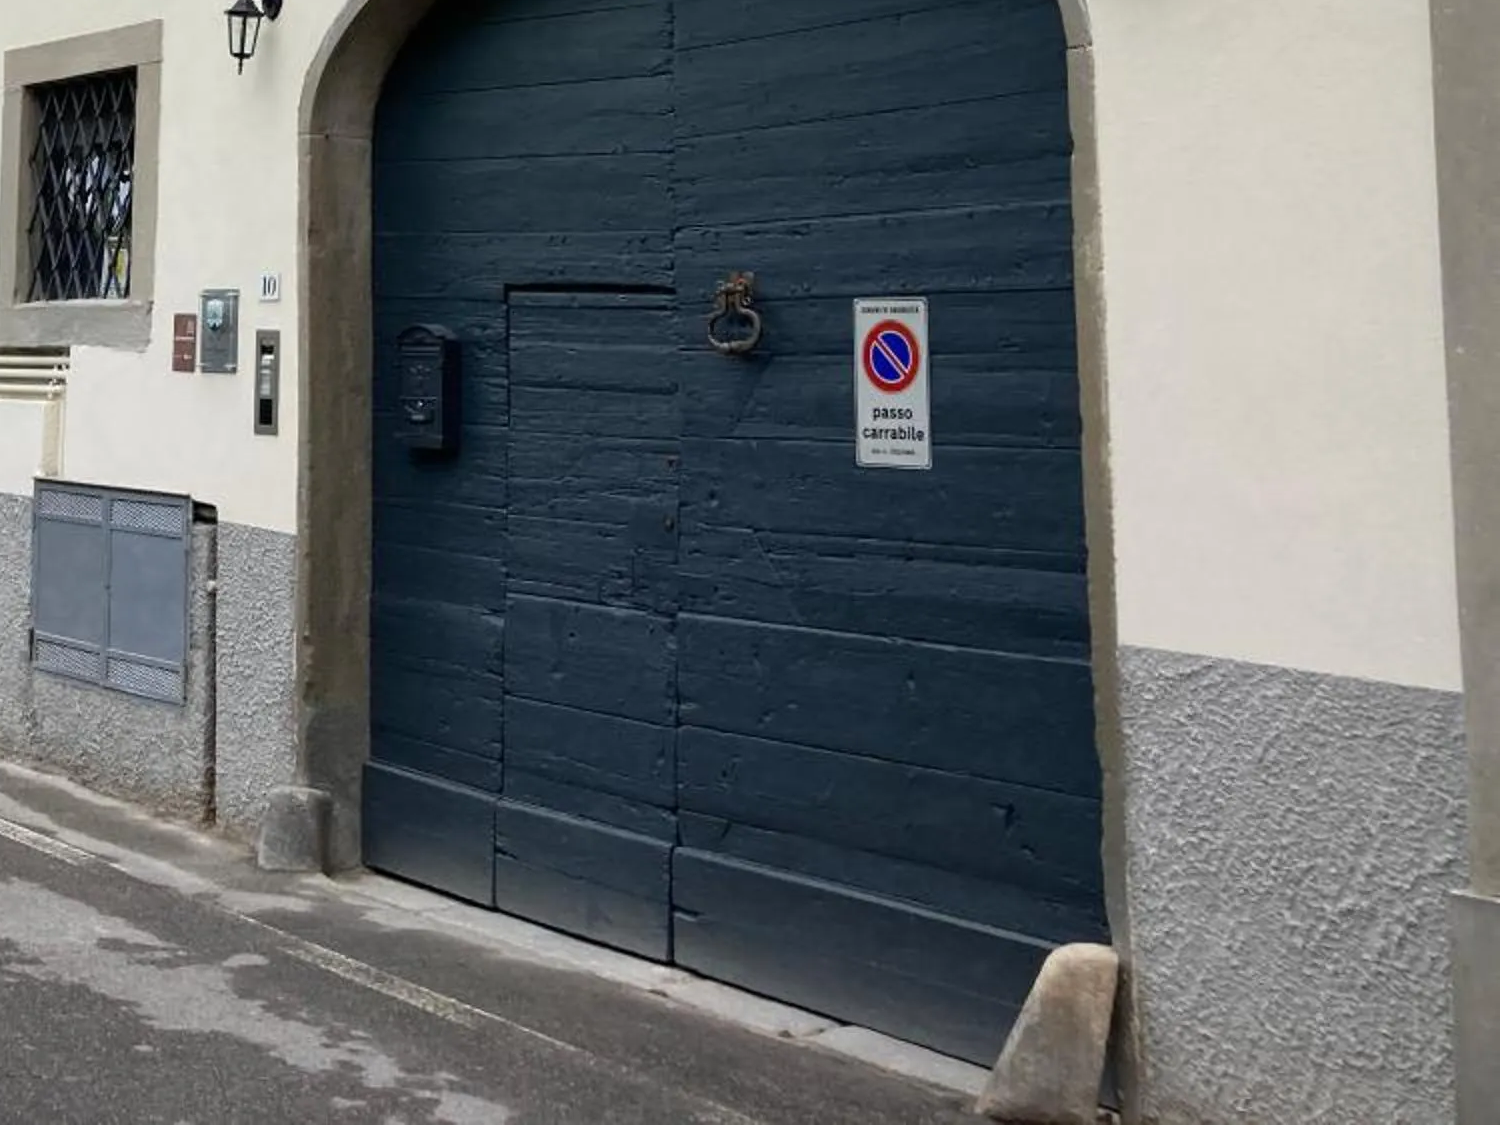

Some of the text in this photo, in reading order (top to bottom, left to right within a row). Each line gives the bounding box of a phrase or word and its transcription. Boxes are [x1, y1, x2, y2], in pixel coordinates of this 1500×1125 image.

[262, 276, 277, 296] 10
[872, 407, 913, 421] passo
[862, 426, 925, 442] carrabile
